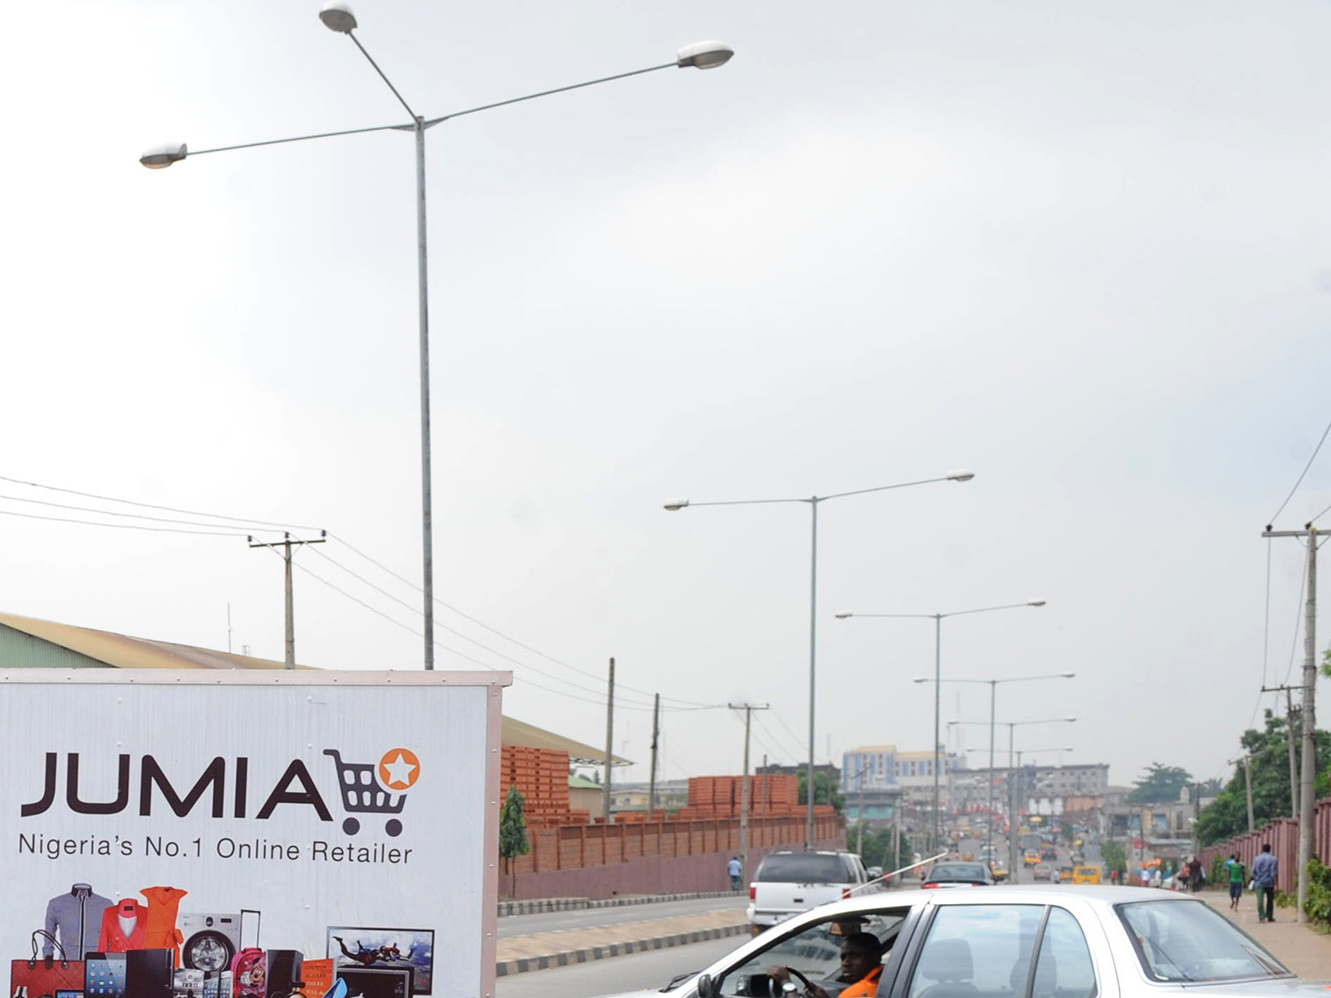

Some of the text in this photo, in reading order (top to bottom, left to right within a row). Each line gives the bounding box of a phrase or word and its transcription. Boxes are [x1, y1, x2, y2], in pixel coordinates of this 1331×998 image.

[20, 751, 334, 822] JUMIA
[18, 833, 413, 864] Nigeria's No.1 Online Retailer
